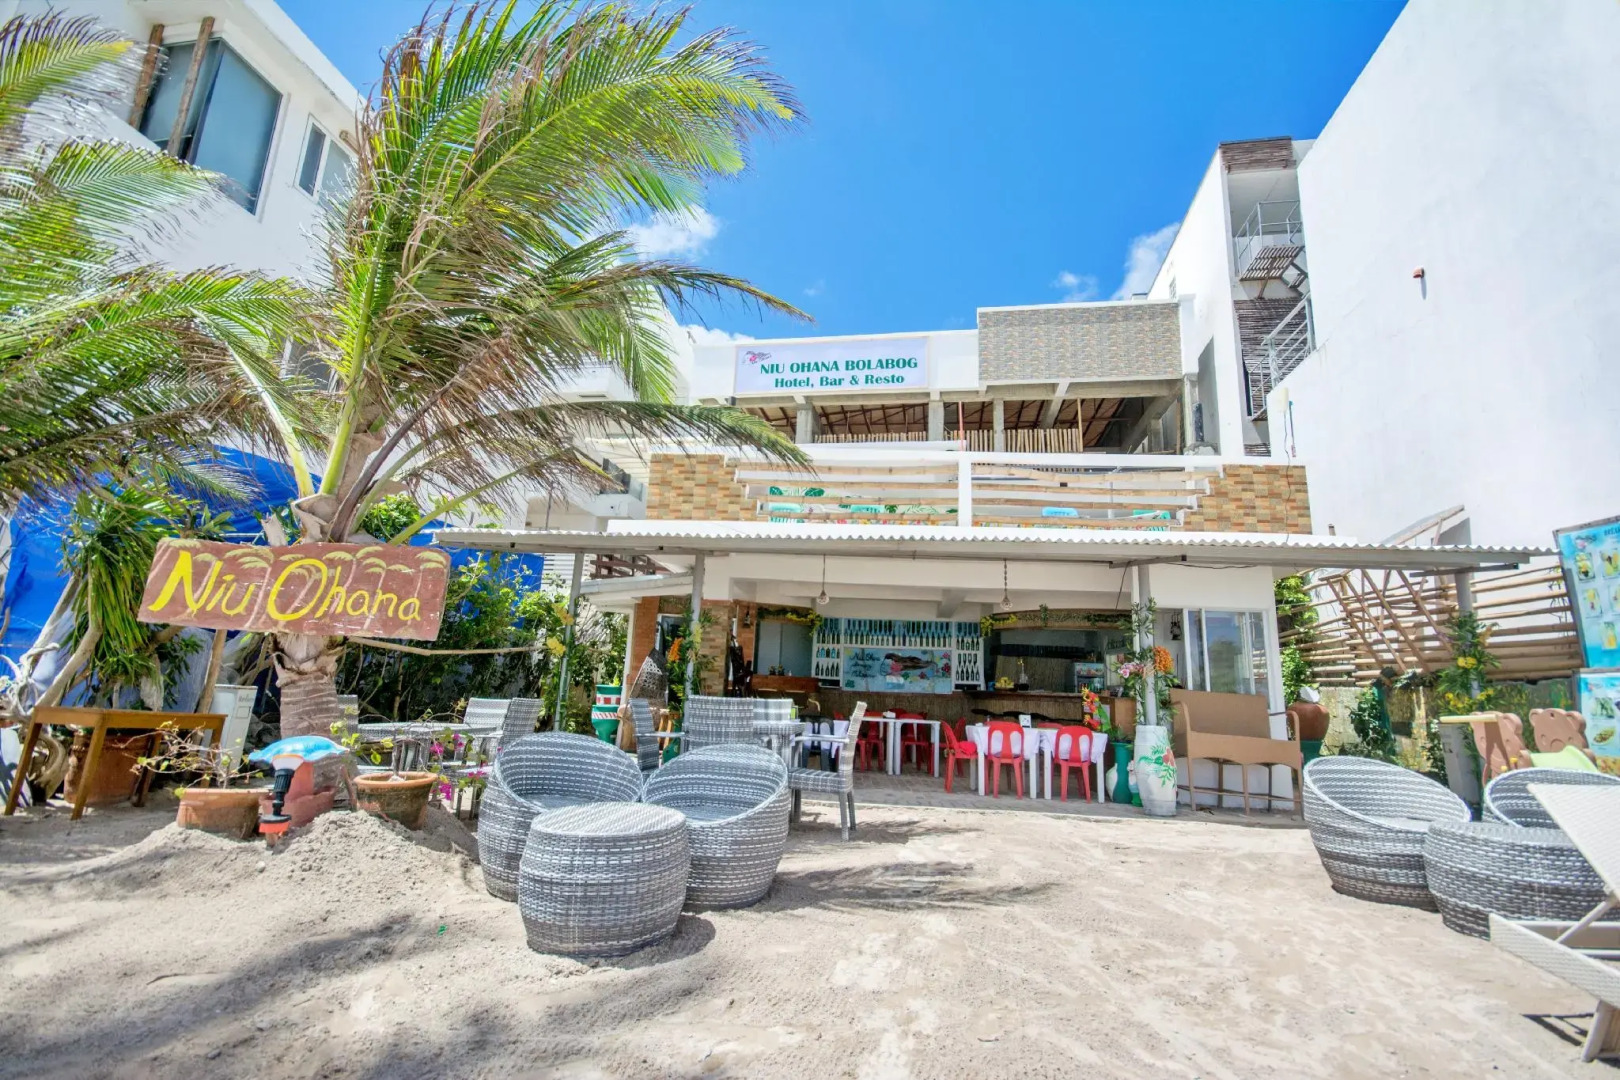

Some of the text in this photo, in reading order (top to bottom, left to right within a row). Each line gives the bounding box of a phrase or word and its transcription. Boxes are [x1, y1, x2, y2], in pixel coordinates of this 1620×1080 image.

[761, 357, 918, 374] NIU OHANA BOLABOG
[774, 373, 905, 388] Hotel, Bar & Resto
[148, 551, 421, 621] Niu Ohana
